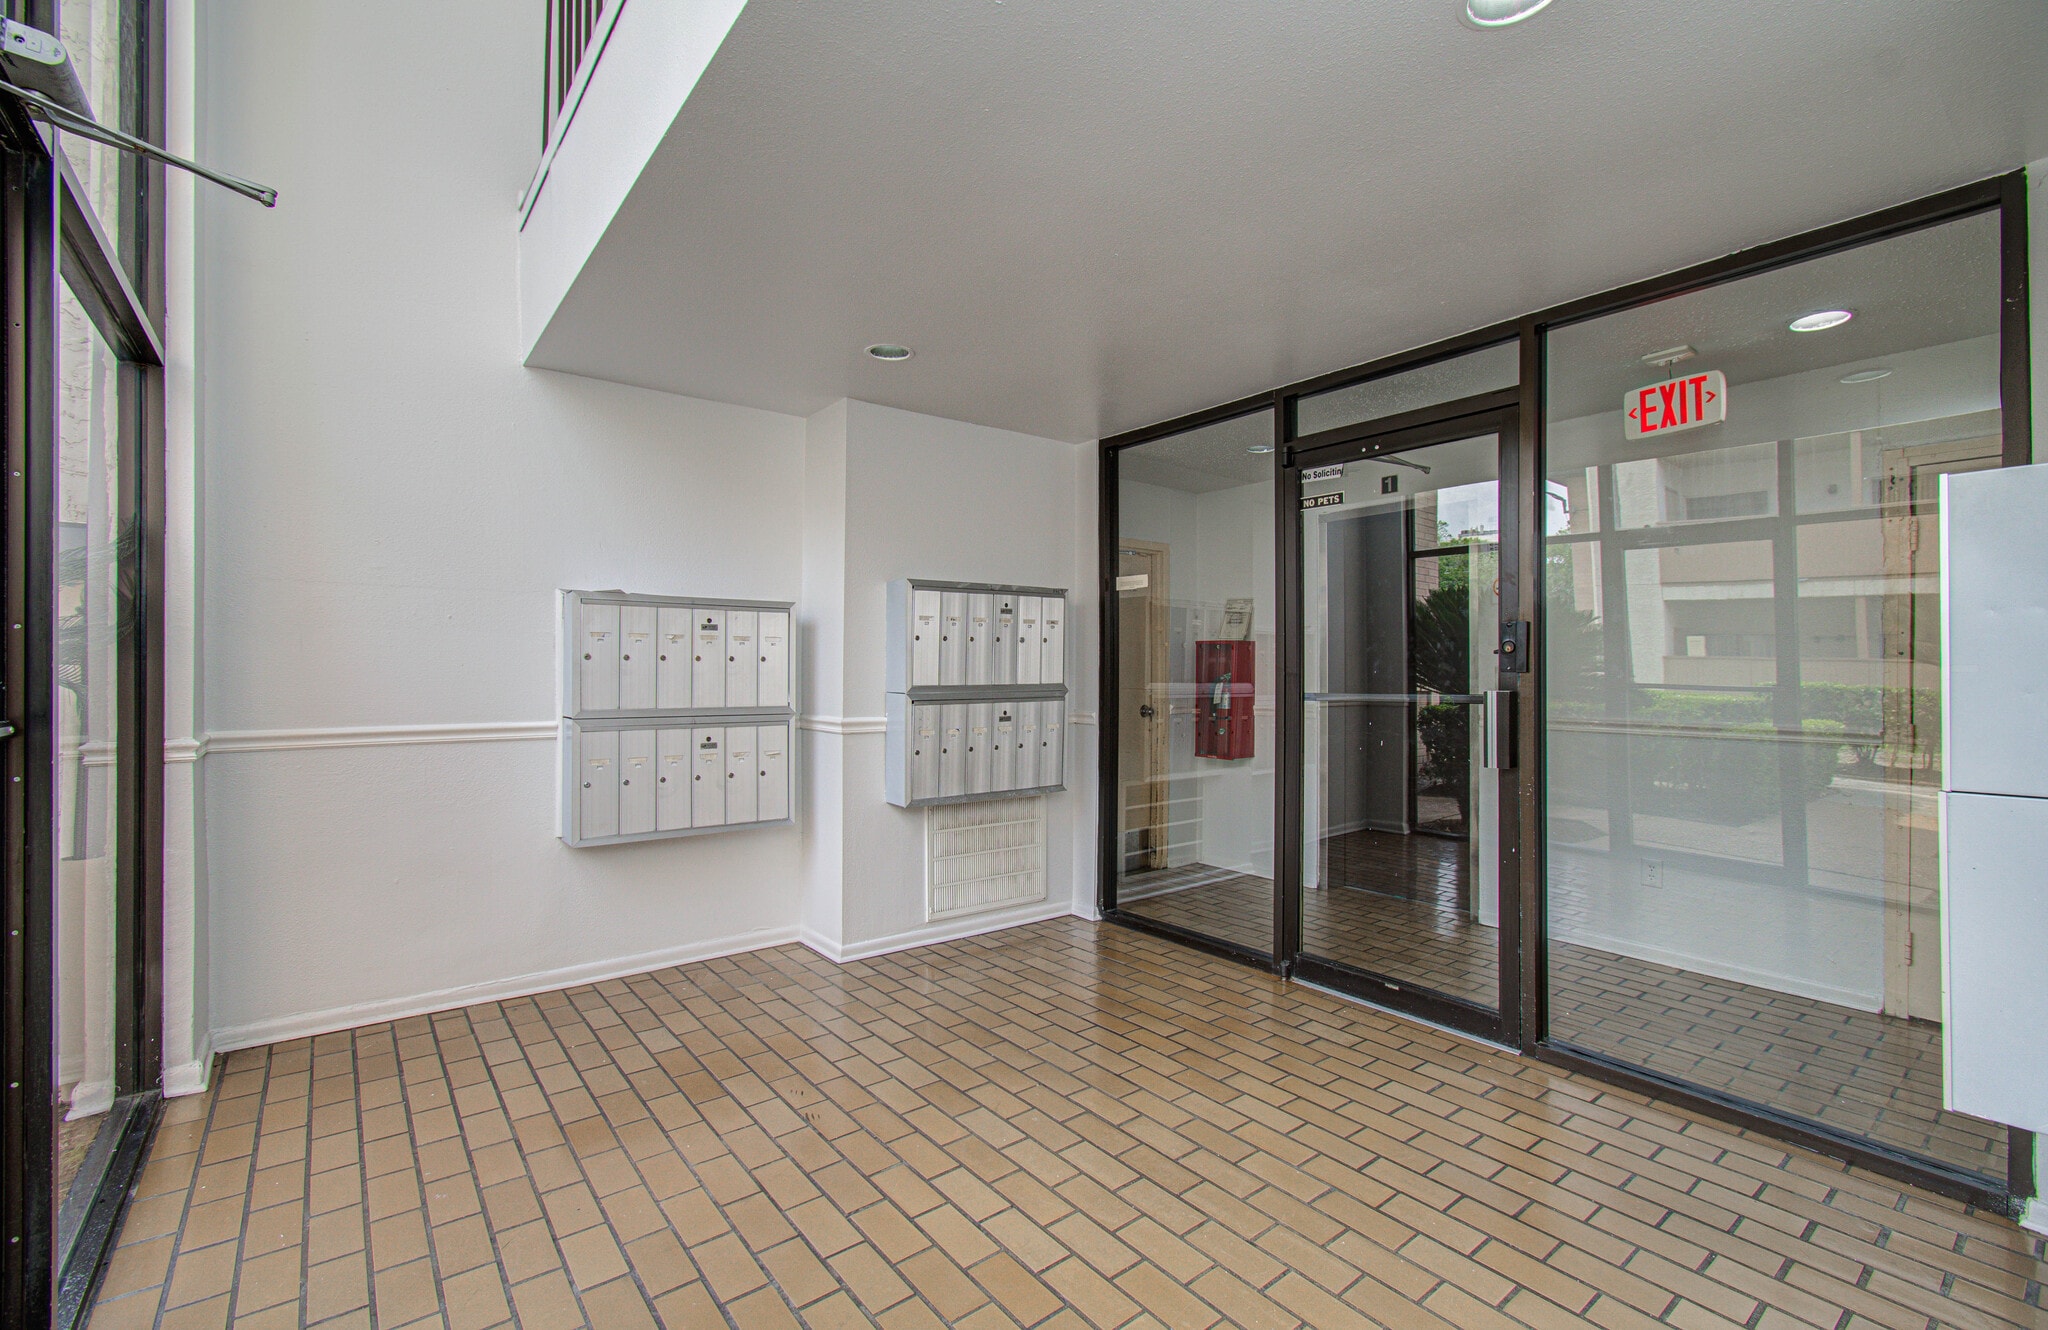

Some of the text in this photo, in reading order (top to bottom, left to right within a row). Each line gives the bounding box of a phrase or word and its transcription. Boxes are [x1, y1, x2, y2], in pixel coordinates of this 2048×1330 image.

[1639, 375, 1708, 433] EXIT
[1302, 472, 1312, 481] No
[1384, 477, 1392, 492] 1
[1303, 495, 1340, 509] NO PETS
